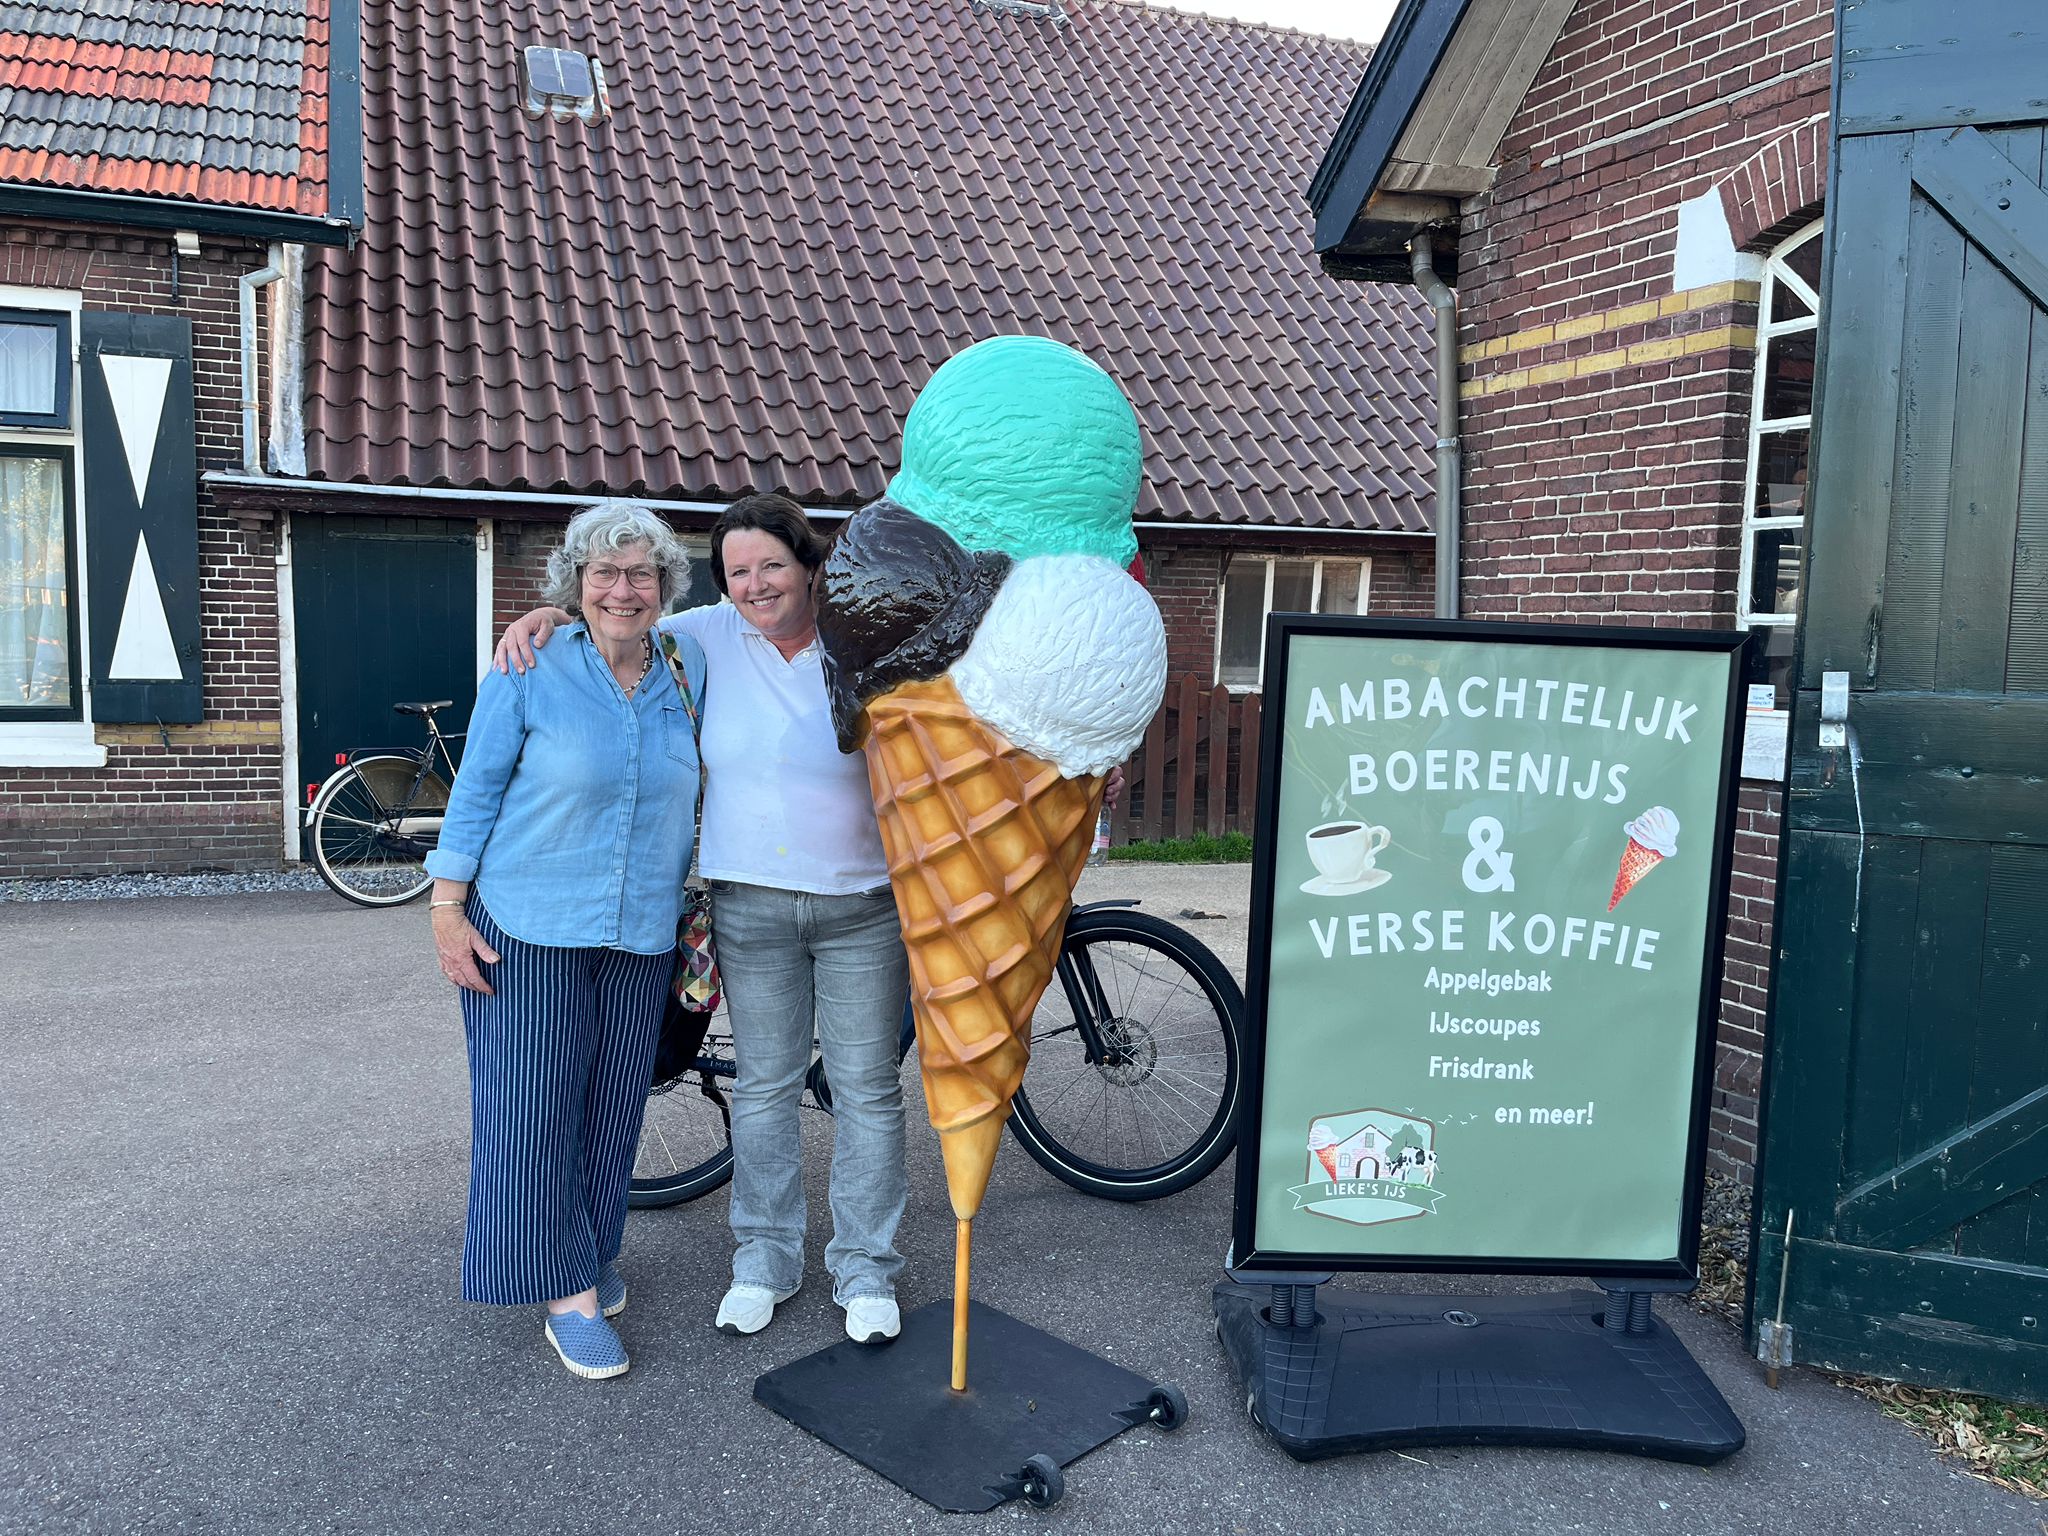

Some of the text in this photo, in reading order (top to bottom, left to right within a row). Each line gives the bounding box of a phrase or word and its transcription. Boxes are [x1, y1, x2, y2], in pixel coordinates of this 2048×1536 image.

[1304, 675, 1699, 746] AMBACHTELIJK
[1349, 749, 1630, 804] BOERENIJS
[1461, 815, 1516, 893] &
[1308, 910, 1661, 971] VERSE KOFFIE
[1424, 966, 1553, 997] Appelgebak
[1429, 1011, 1542, 1041] IJscoupes
[1429, 1055, 1535, 1080] Frisdrank
[1494, 1101, 1595, 1126] en meer!
[1325, 1181, 1407, 1199] LIEKE'S IJS
